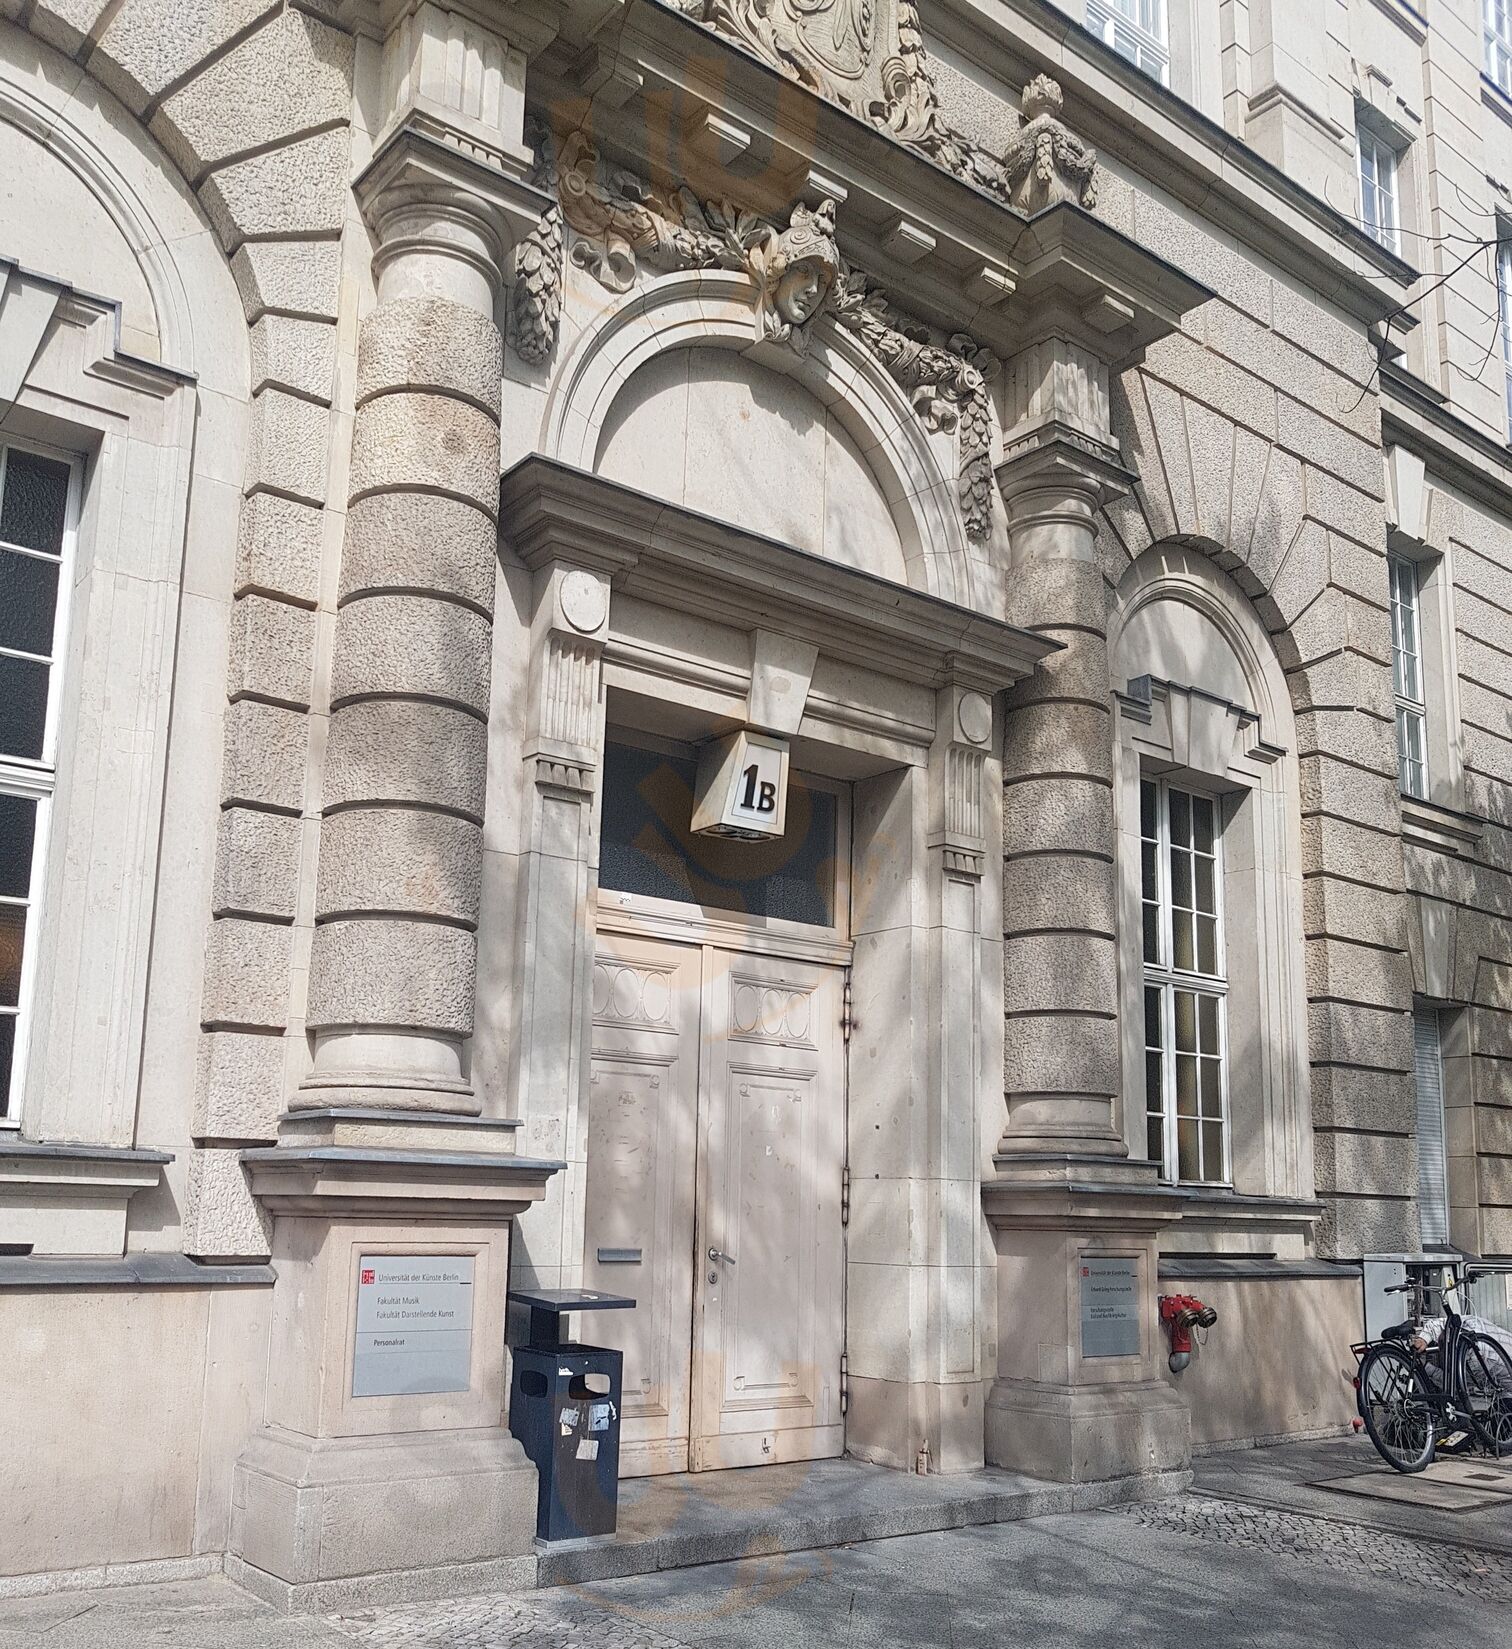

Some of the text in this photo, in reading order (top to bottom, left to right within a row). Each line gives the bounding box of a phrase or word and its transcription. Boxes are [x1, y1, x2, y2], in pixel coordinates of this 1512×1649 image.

[740, 764, 776, 812] 1B
[378, 1273, 459, 1281] Universität der Künste Berlin
[377, 1296, 420, 1305] Fakultät Musik
[376, 1311, 400, 1319] Fakultät
[401, 1310, 437, 1318] Darstellende
